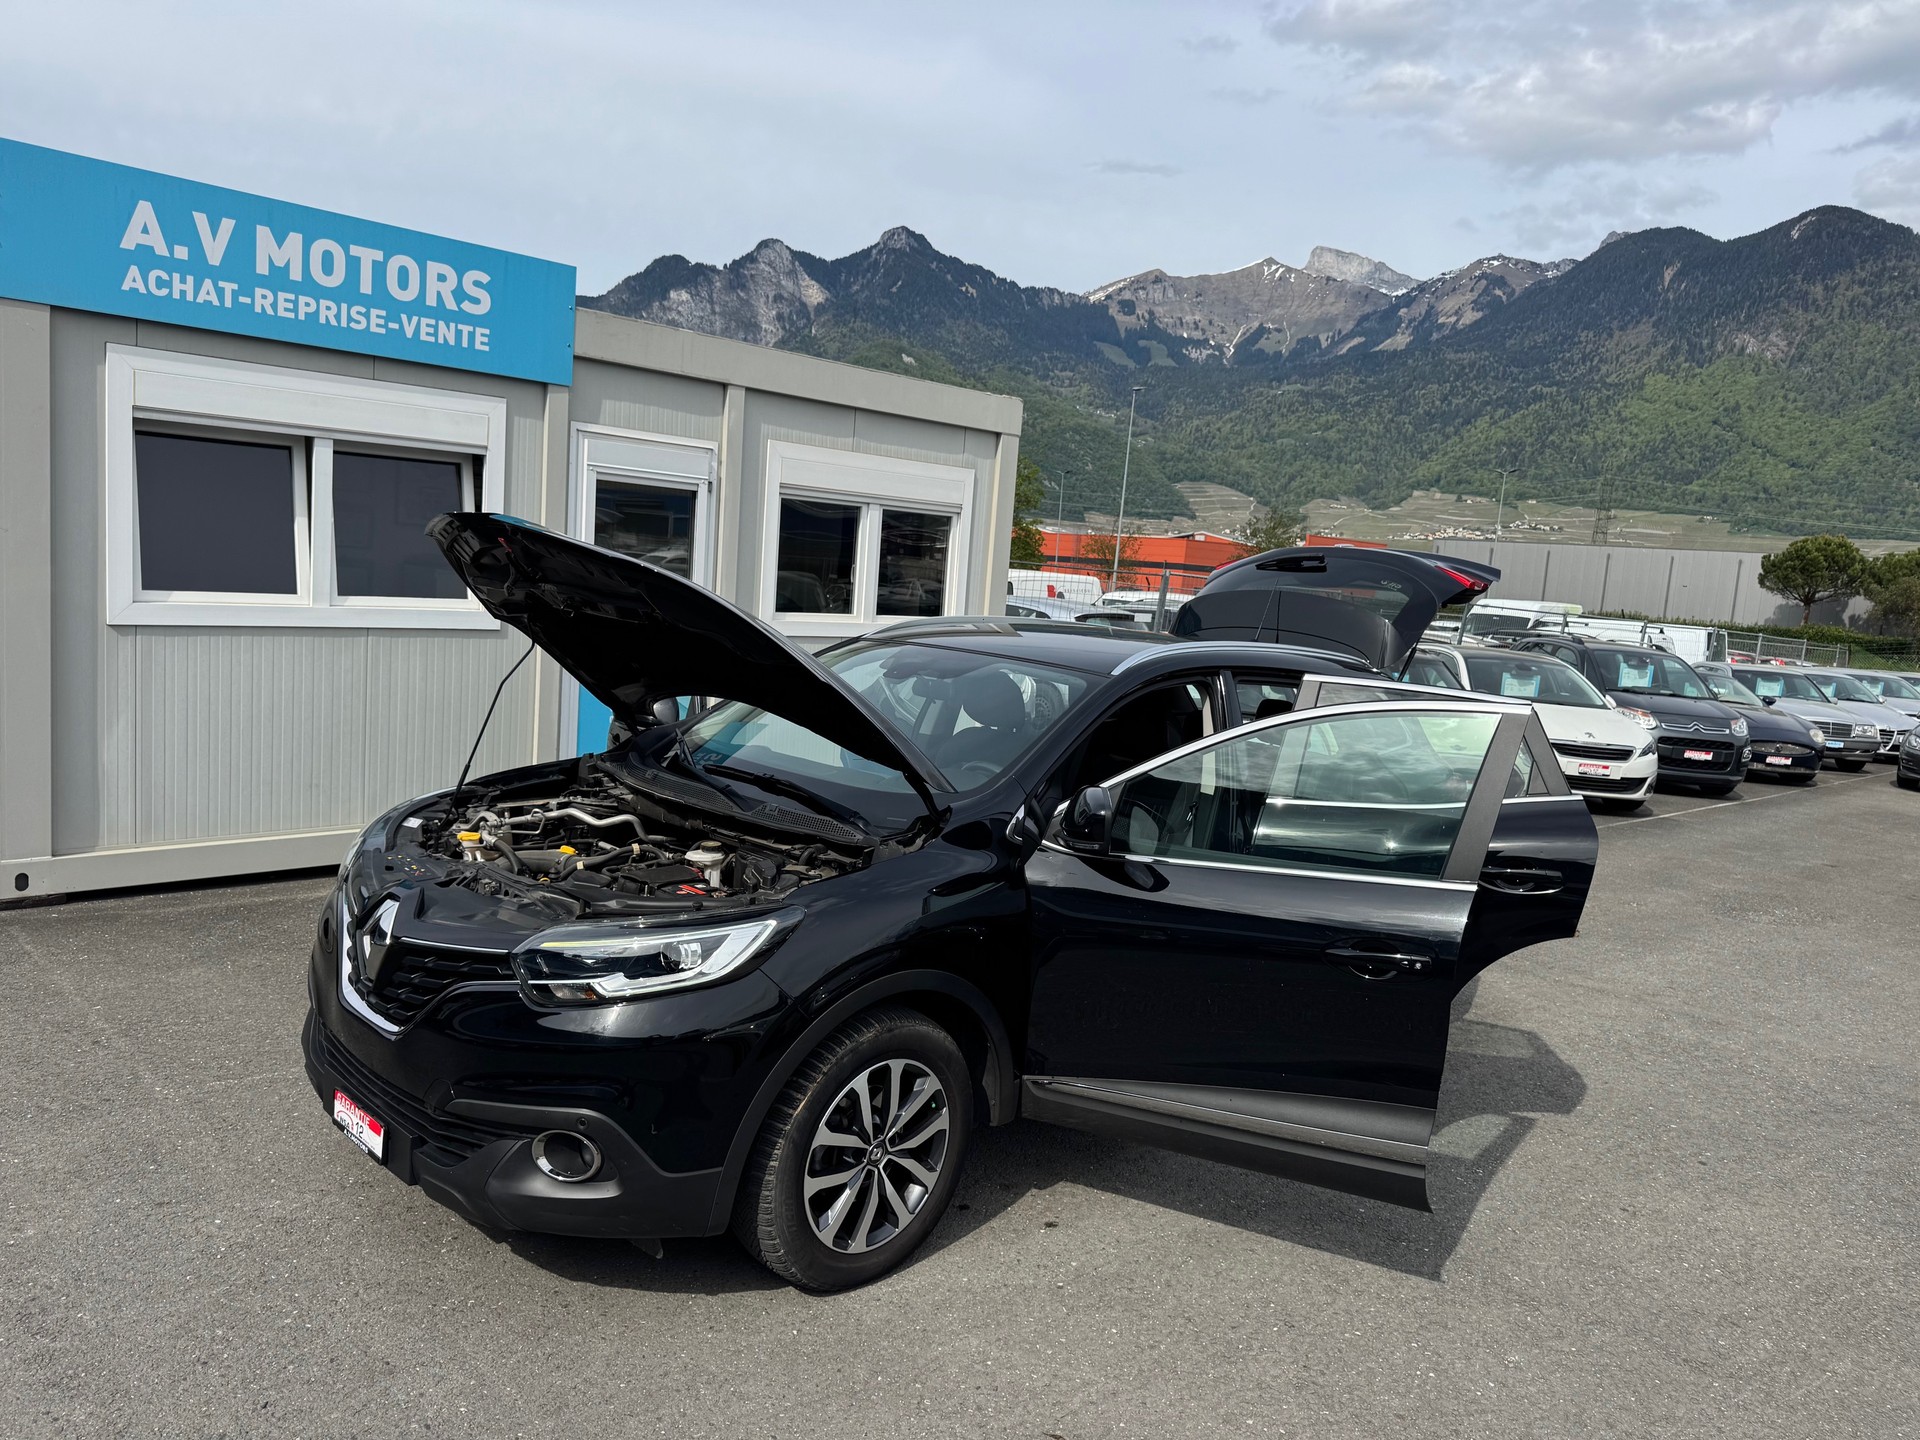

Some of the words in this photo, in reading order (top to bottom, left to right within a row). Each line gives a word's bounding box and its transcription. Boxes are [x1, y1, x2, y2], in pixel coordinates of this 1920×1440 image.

[120, 201, 236, 266] A.V
[255, 224, 493, 316] MOTORS
[121, 265, 491, 352] ACHAT-REPRISE-VENTE
[336, 1092, 371, 1127] GARANTIE
[355, 1121, 364, 1140] 12
